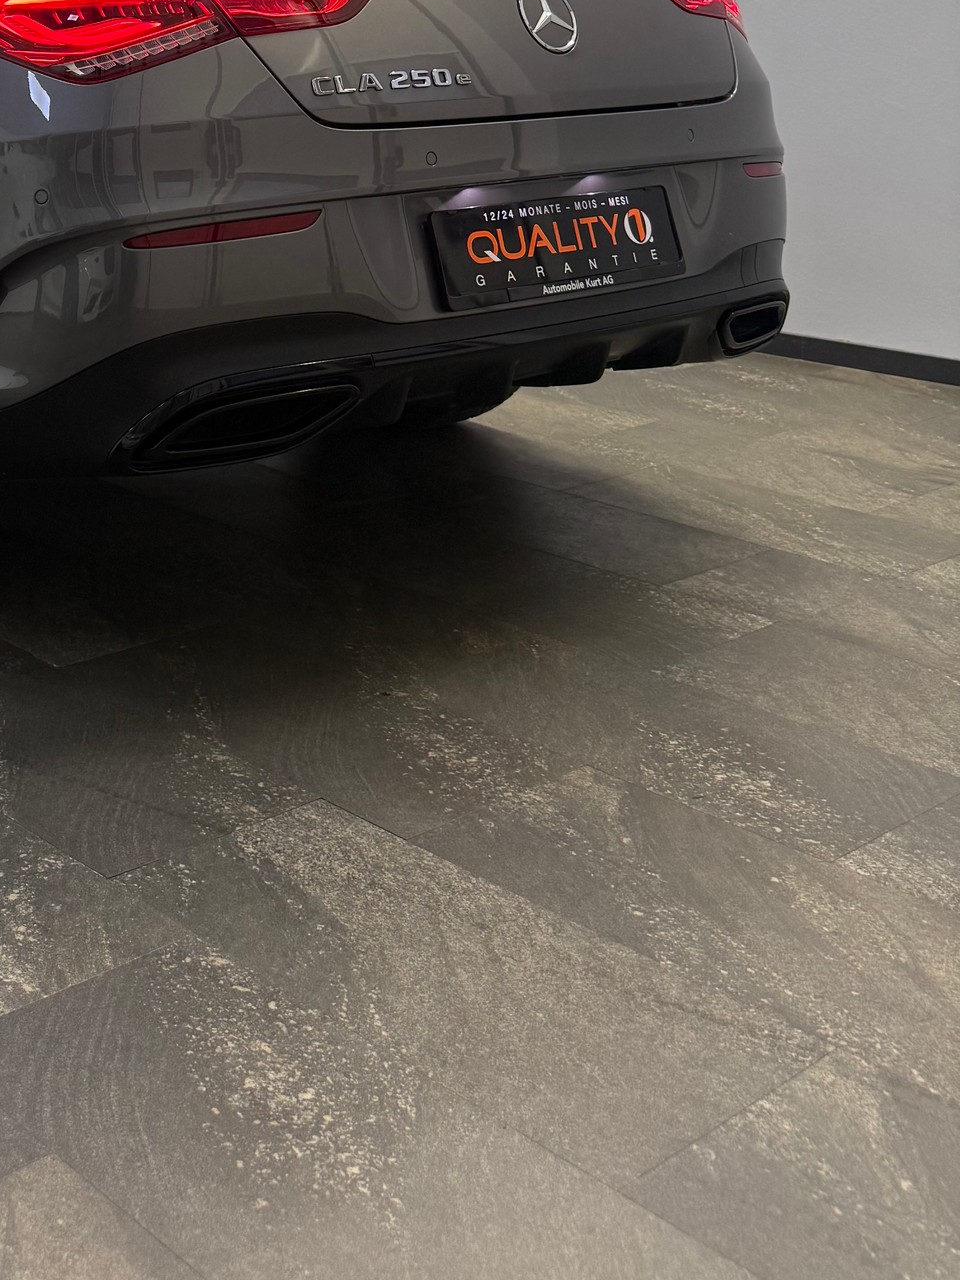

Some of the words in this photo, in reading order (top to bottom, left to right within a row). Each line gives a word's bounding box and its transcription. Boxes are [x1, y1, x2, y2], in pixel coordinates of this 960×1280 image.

[311, 73, 383, 96] CLA
[483, 209, 514, 222] 12/24
[518, 203, 562, 218] MONATE
[573, 199, 598, 211] MOIS
[607, 195, 629, 207] MESI
[466, 213, 619, 264] QUALITY
[475, 249, 658, 287] GARANTIE
[542, 280, 585, 295] Automobile
[584, 277, 602, 288] Kurt
[602, 274, 614, 286] AG
